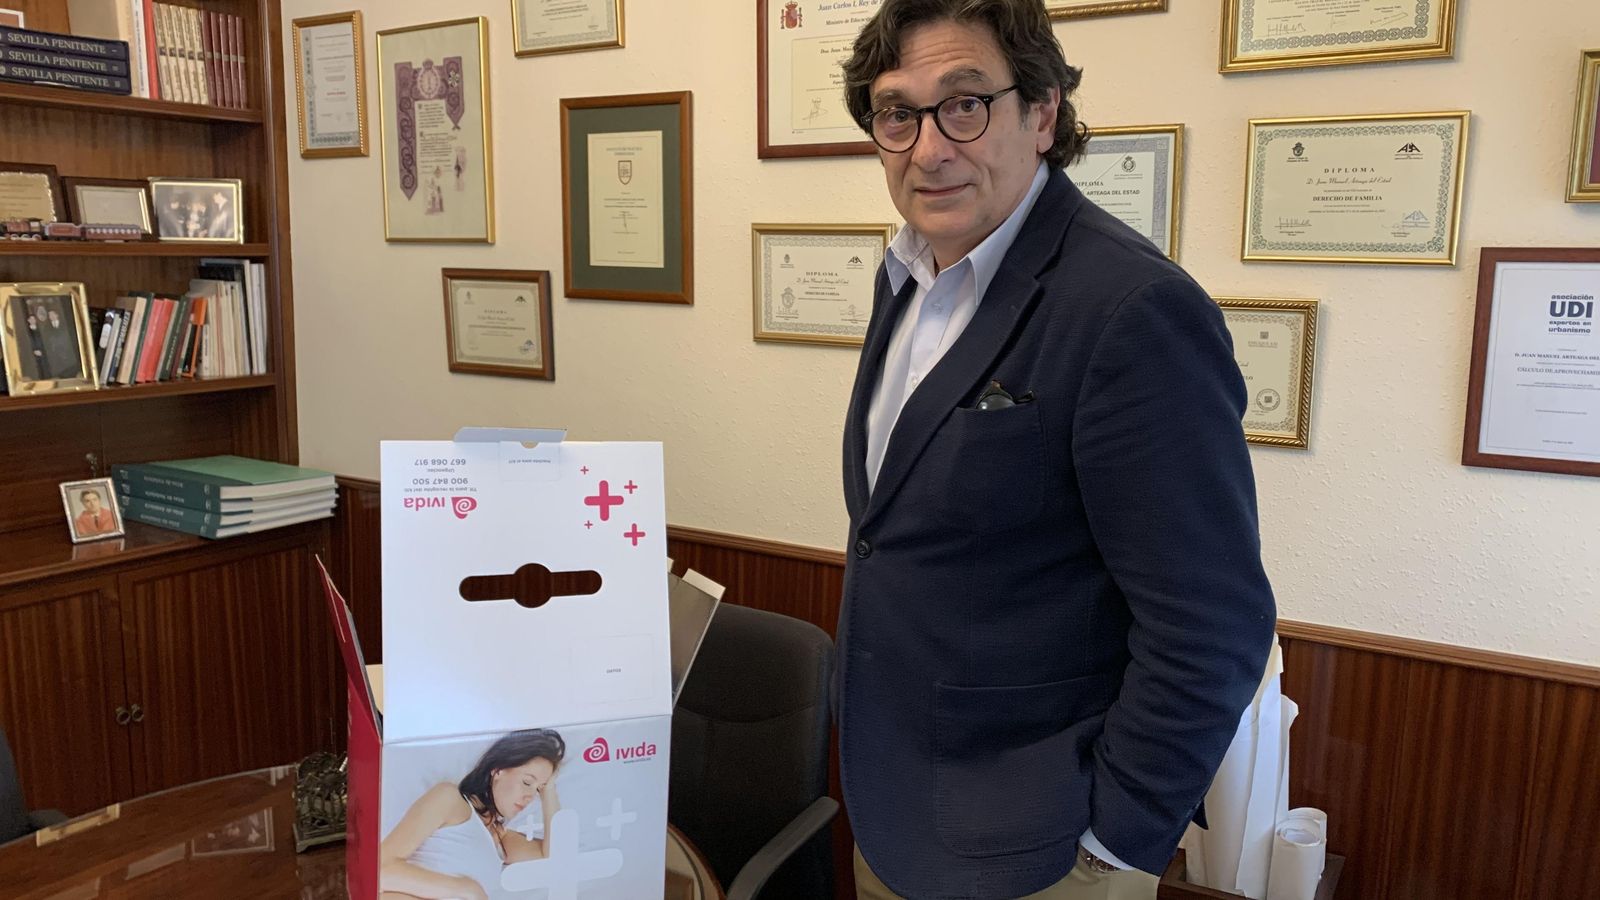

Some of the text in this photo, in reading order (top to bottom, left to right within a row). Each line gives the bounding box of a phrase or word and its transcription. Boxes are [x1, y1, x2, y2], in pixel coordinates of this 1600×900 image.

[8, 32, 50, 46] SEVILLA
[52, 39, 106, 54] PENITENTE
[9, 50, 50, 64] SEVILLA
[53, 56, 107, 71] PENITENTE
[12, 67, 53, 80] SEVILLA
[56, 72, 110, 87] PENITENTE
[1550, 301, 1593, 318] UDI
[404, 497, 445, 511] ivida
[616, 742, 656, 760] ivida
